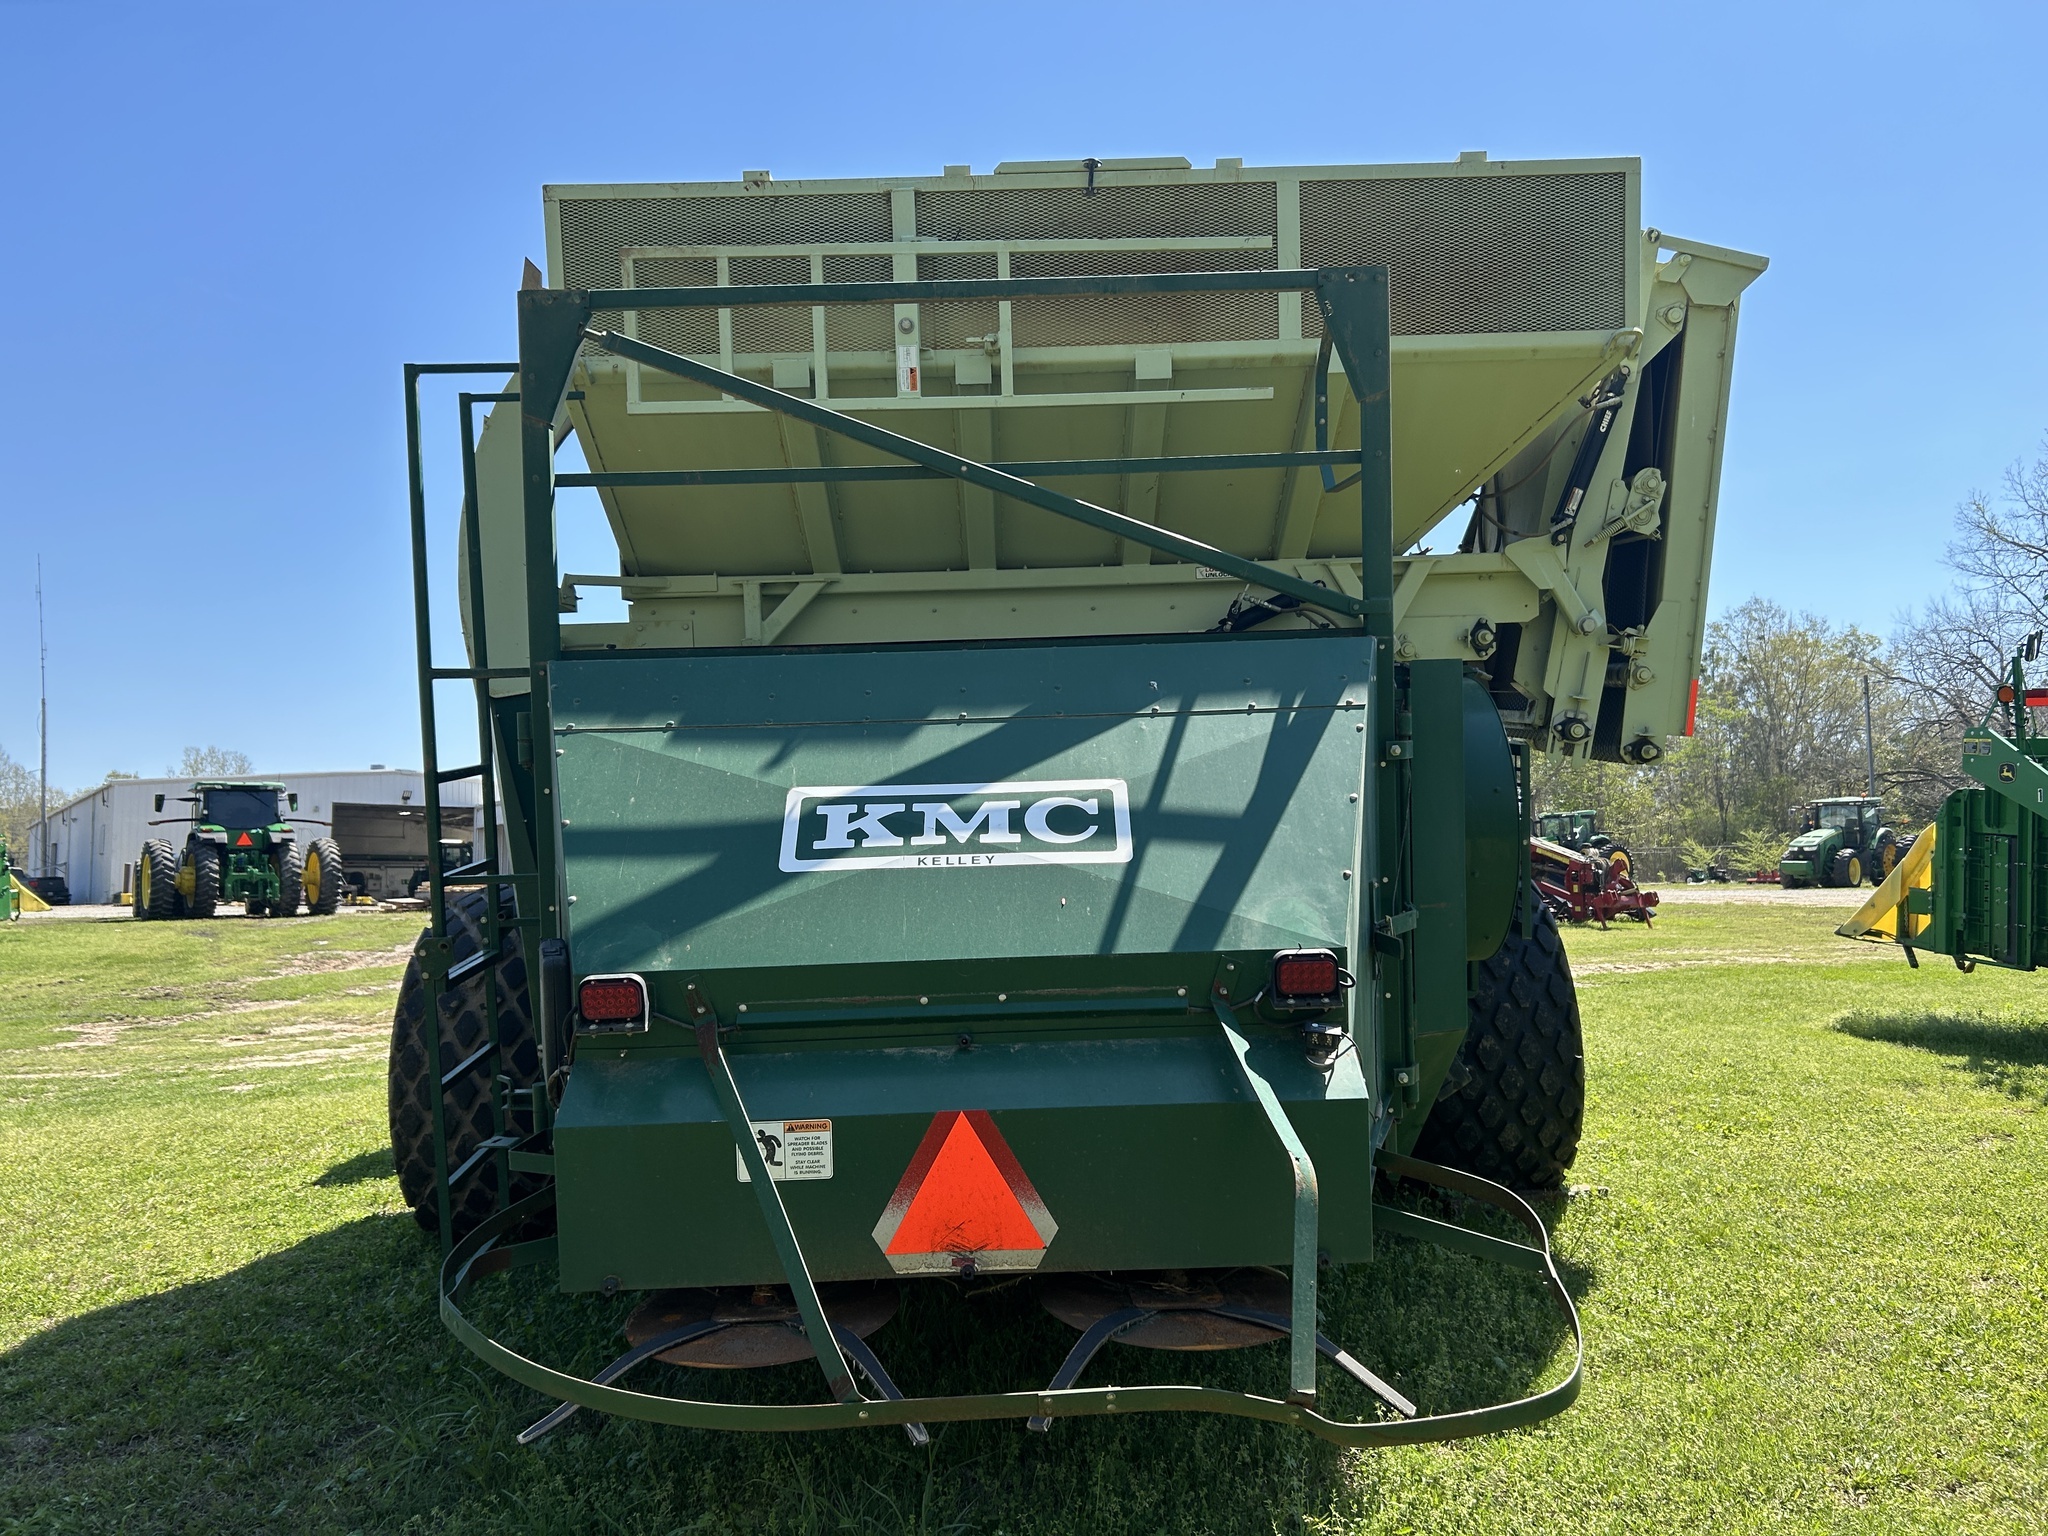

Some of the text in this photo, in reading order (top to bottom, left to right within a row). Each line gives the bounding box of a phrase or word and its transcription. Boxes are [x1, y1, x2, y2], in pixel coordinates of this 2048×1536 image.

[1600, 410, 1612, 432] CHIEF
[812, 797, 1099, 850] KMC
[917, 855, 996, 867] KELLEY
